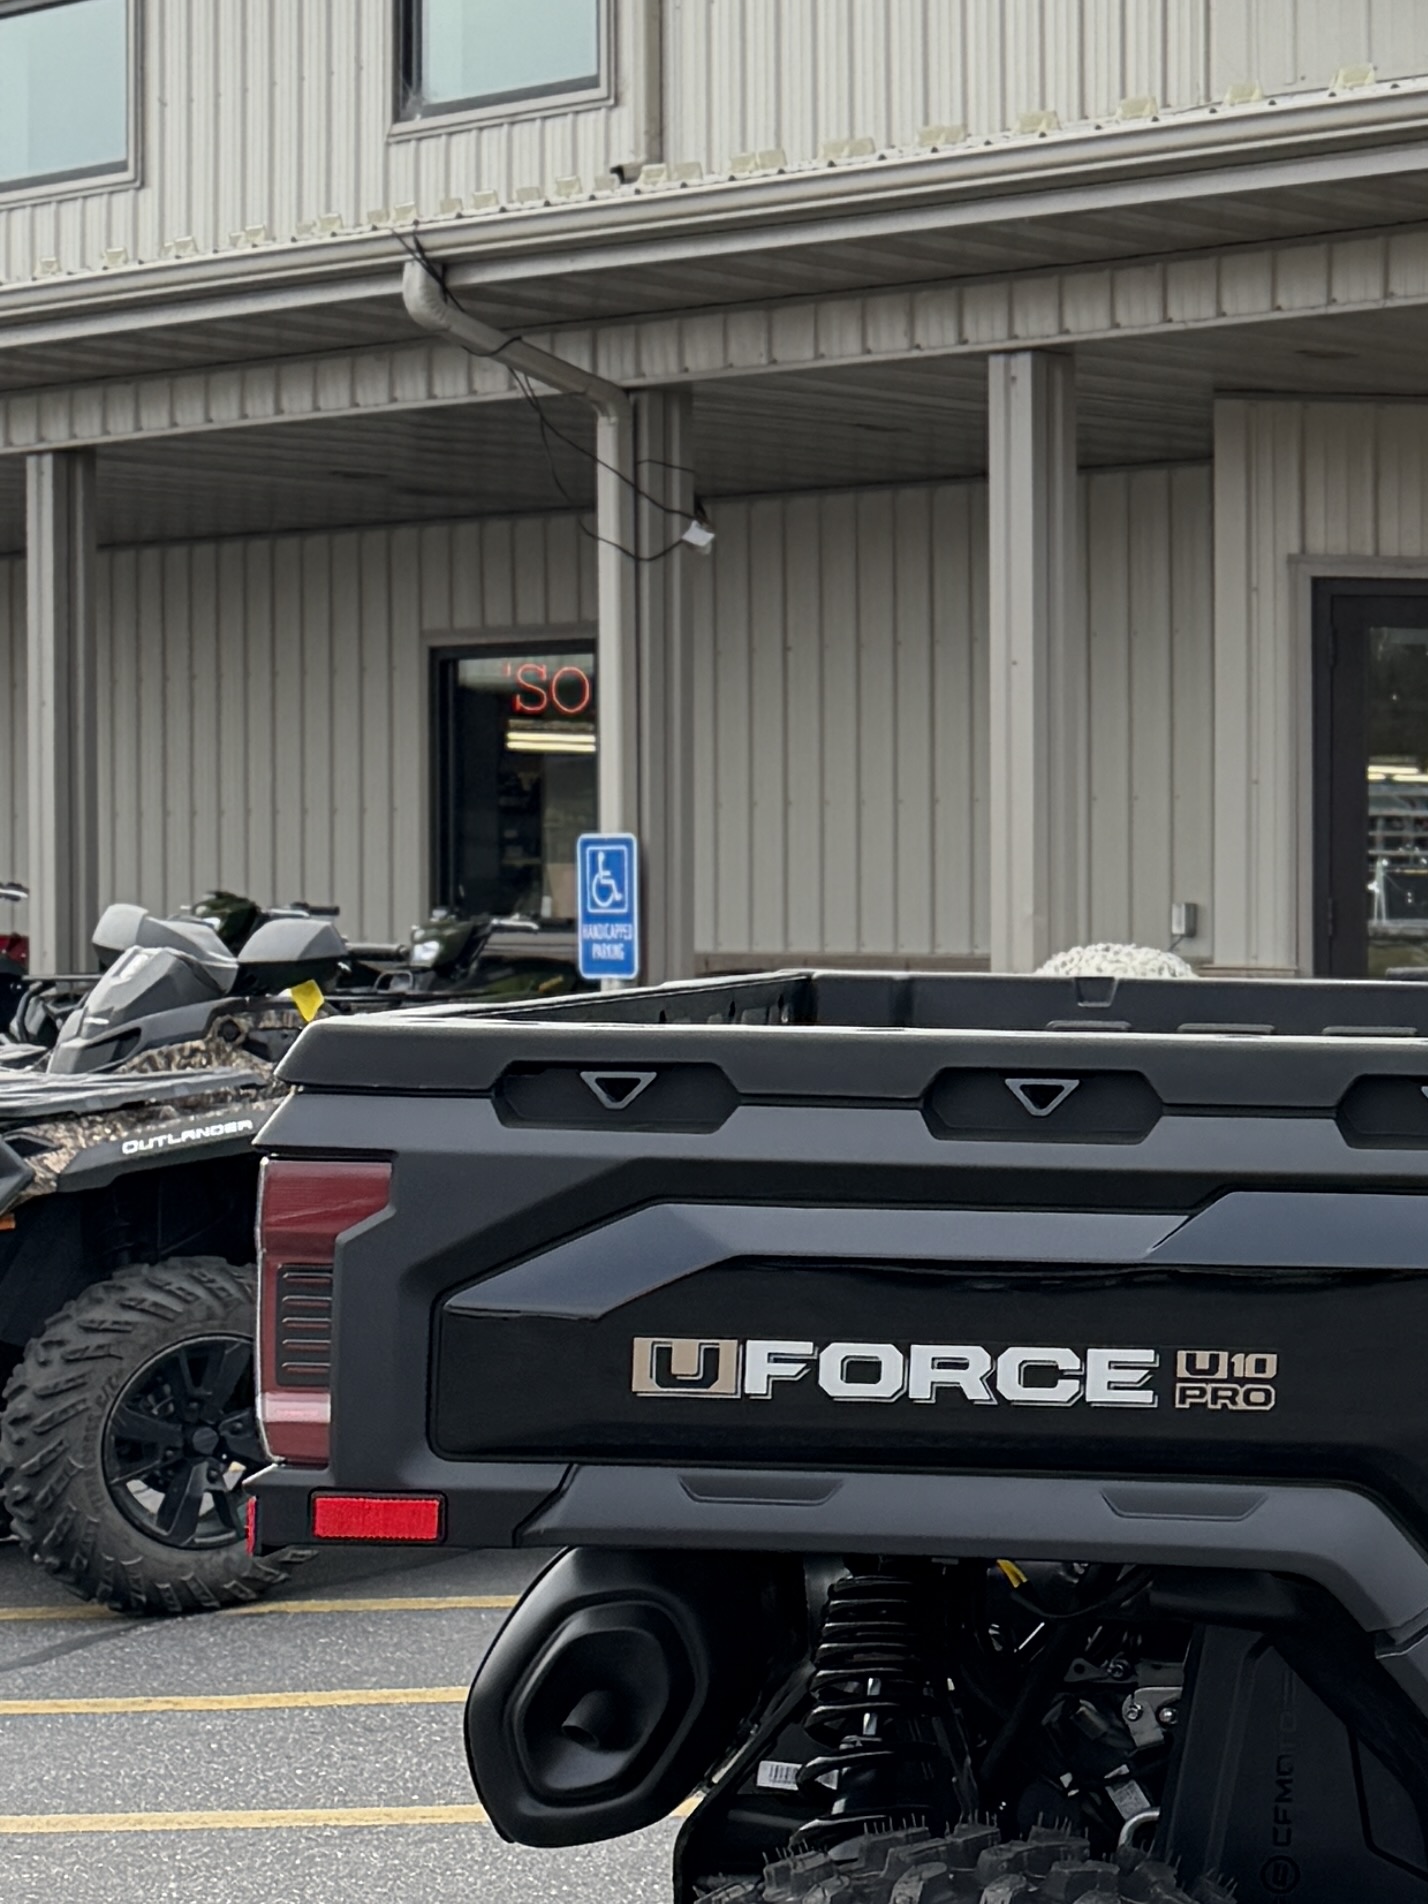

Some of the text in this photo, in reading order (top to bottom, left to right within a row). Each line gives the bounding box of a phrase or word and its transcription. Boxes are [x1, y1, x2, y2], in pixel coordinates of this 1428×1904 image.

[582, 924, 632, 940] HANDICAPPED
[592, 944, 625, 960] PARKING
[122, 1120, 253, 1155] OUTLANDER
[1175, 1383, 1277, 1412] PRO
